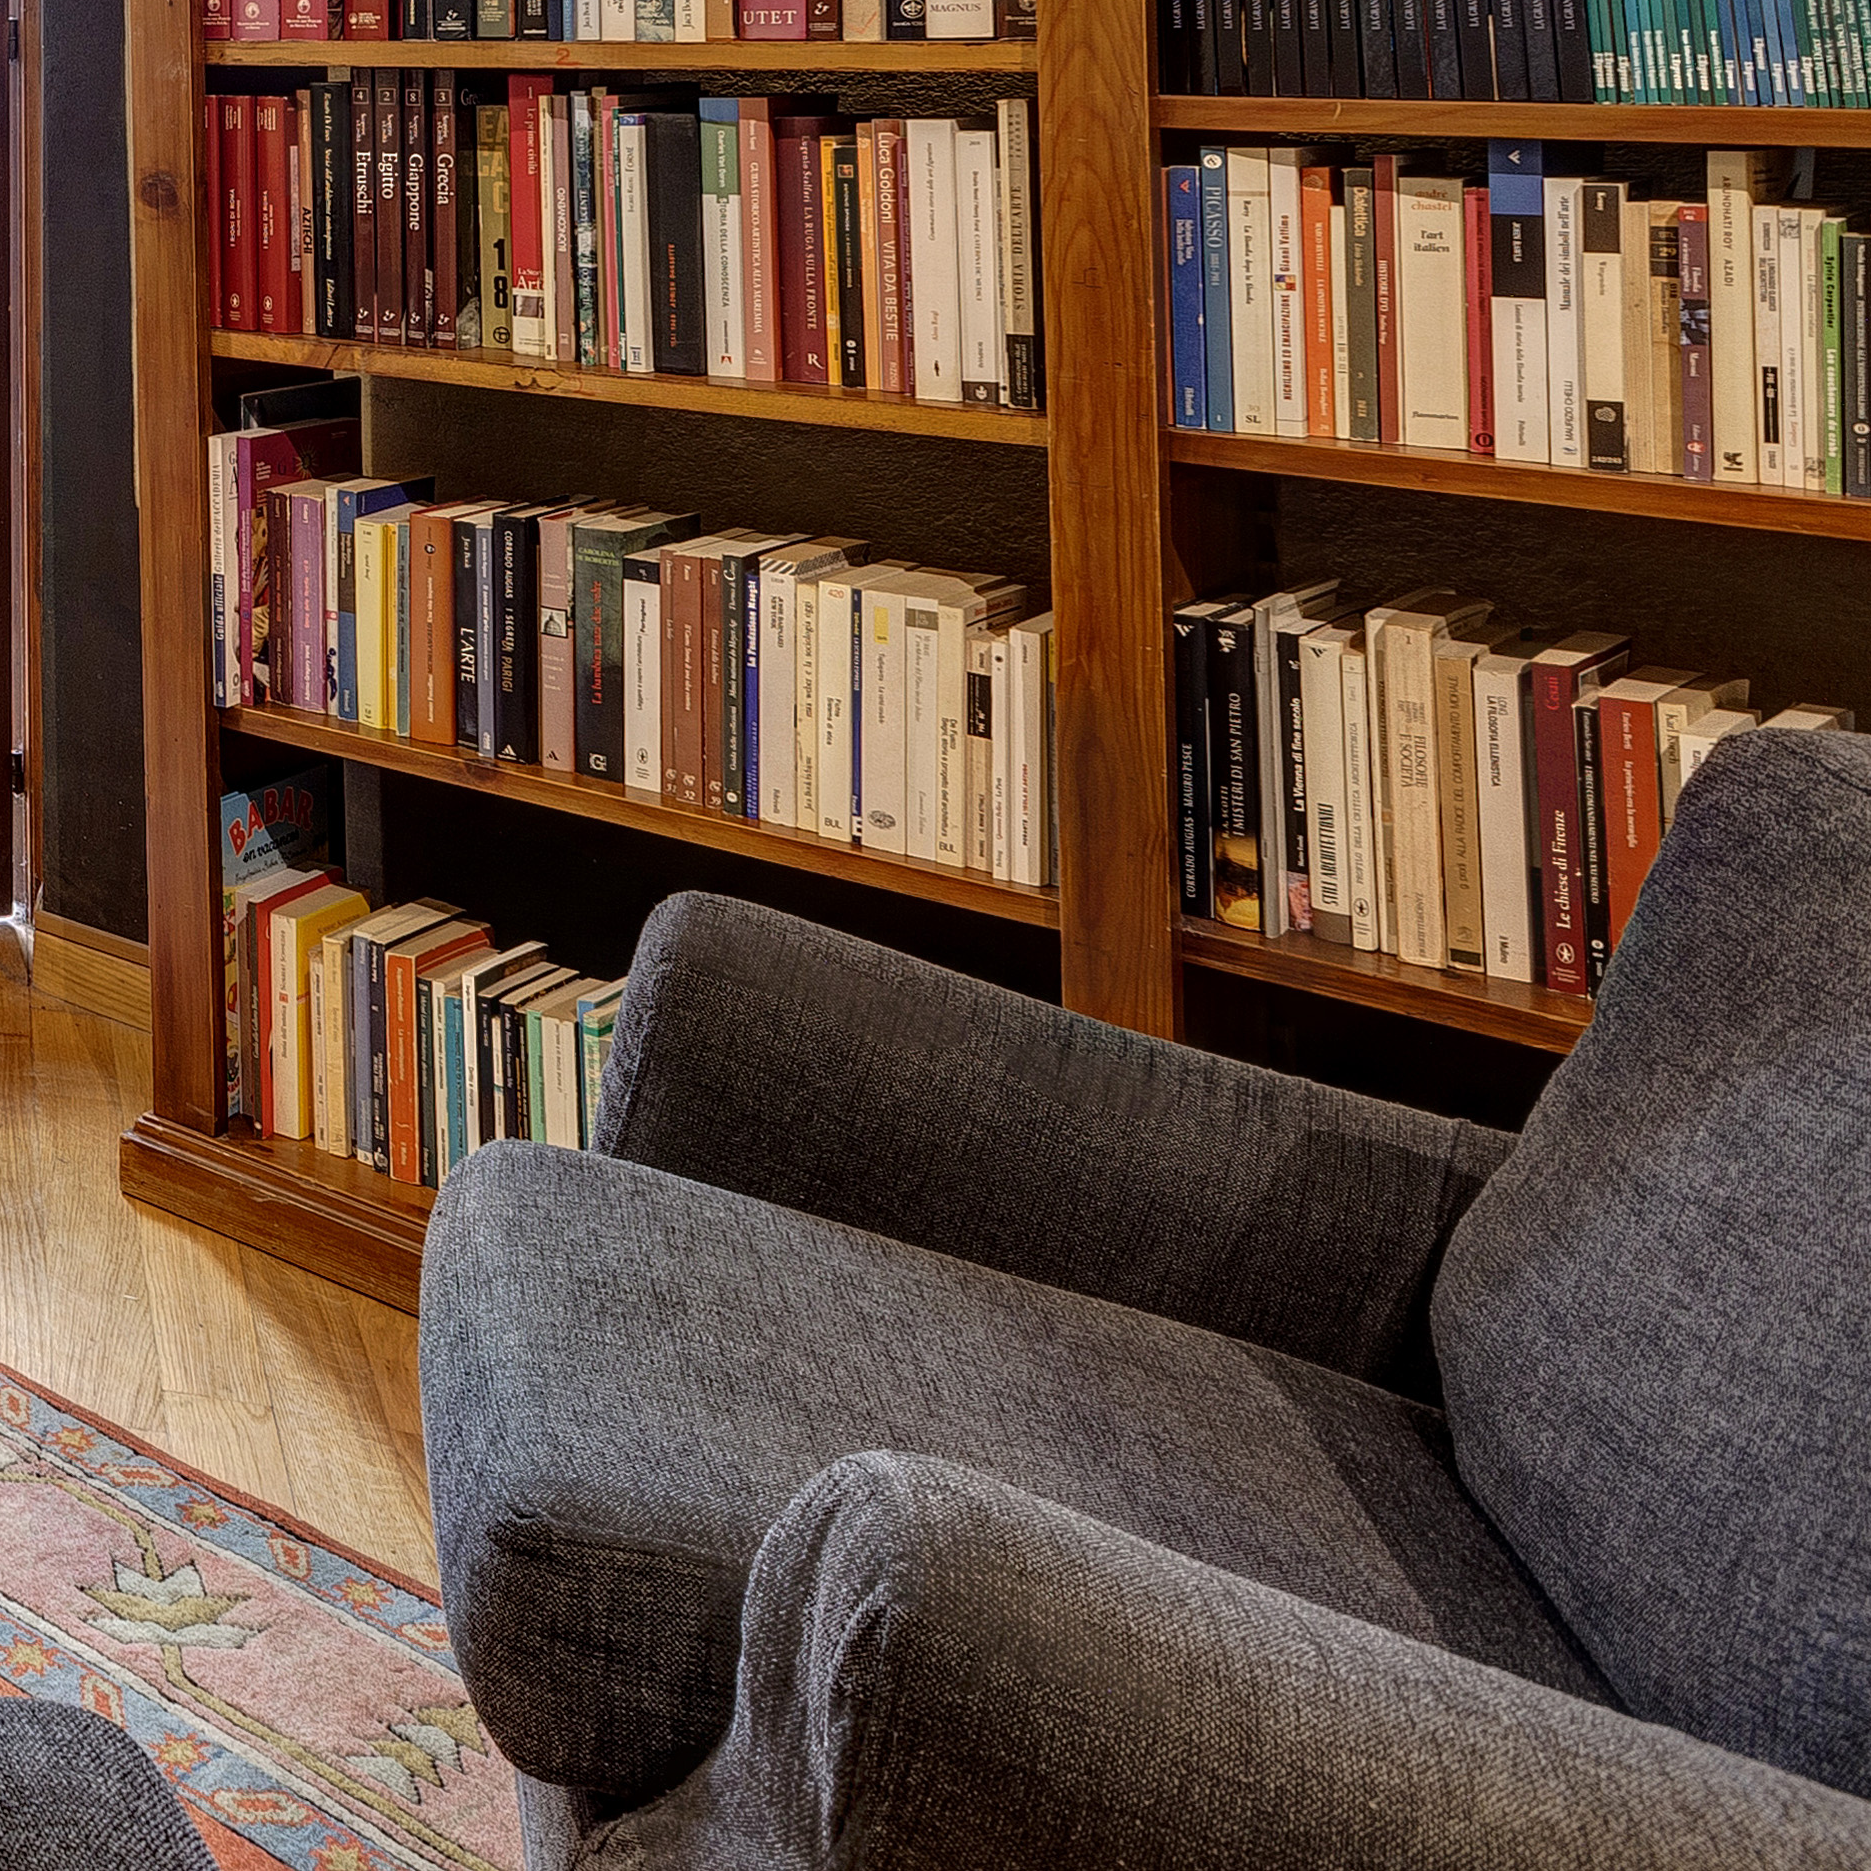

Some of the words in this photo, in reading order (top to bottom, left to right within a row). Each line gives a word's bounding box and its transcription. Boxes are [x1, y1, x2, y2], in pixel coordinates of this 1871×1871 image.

[743, 10, 797, 25] UTET
[930, 2, 981, 13] MAGNUS
[800, 136, 812, 169] Eugenio
[878, 132, 893, 163] Luca
[355, 152, 372, 214] Etruschi
[378, 152, 398, 199] Egitto
[406, 153, 423, 230] Giappone
[436, 153, 454, 204] Grecia
[802, 170, 813, 203] Scalfari
[879, 167, 895, 223] Goldoni
[804, 206, 814, 219] LA
[1010, 186, 1023, 255] DELL'ARTE
[1204, 186, 1223, 248] PICASSO
[1353, 187, 1368, 236] Dialettica
[1411, 200, 1452, 212] chastel
[302, 207, 313, 254] AZTECHI
[720, 229, 729, 253] DELLA
[804, 222, 814, 250] RUGA
[1413, 242, 1450, 253] italien
[1420, 229, 1443, 242] l'art
[805, 253, 815, 286] SULLA
[882, 240, 896, 269] VITA
[719, 255, 730, 307] CONOSCENZA
[884, 273, 896, 292] DA
[1011, 264, 1025, 310] STORIA
[806, 289, 817, 329] FRONTE
[885, 297, 897, 341] BESTIE
[460, 628, 475, 683] L'ARTE
[1228, 693, 1242, 736] PIETRO
[1230, 738, 1242, 762] SAN
[228, 786, 313, 857] BABAR
[1231, 782, 1244, 830] MISTERI
[1317, 803, 1337, 877] ARCHITETTONICI
[1552, 810, 1567, 854] Firenze
[1321, 879, 1338, 907] STILI
[1554, 873, 1569, 910] chiese
